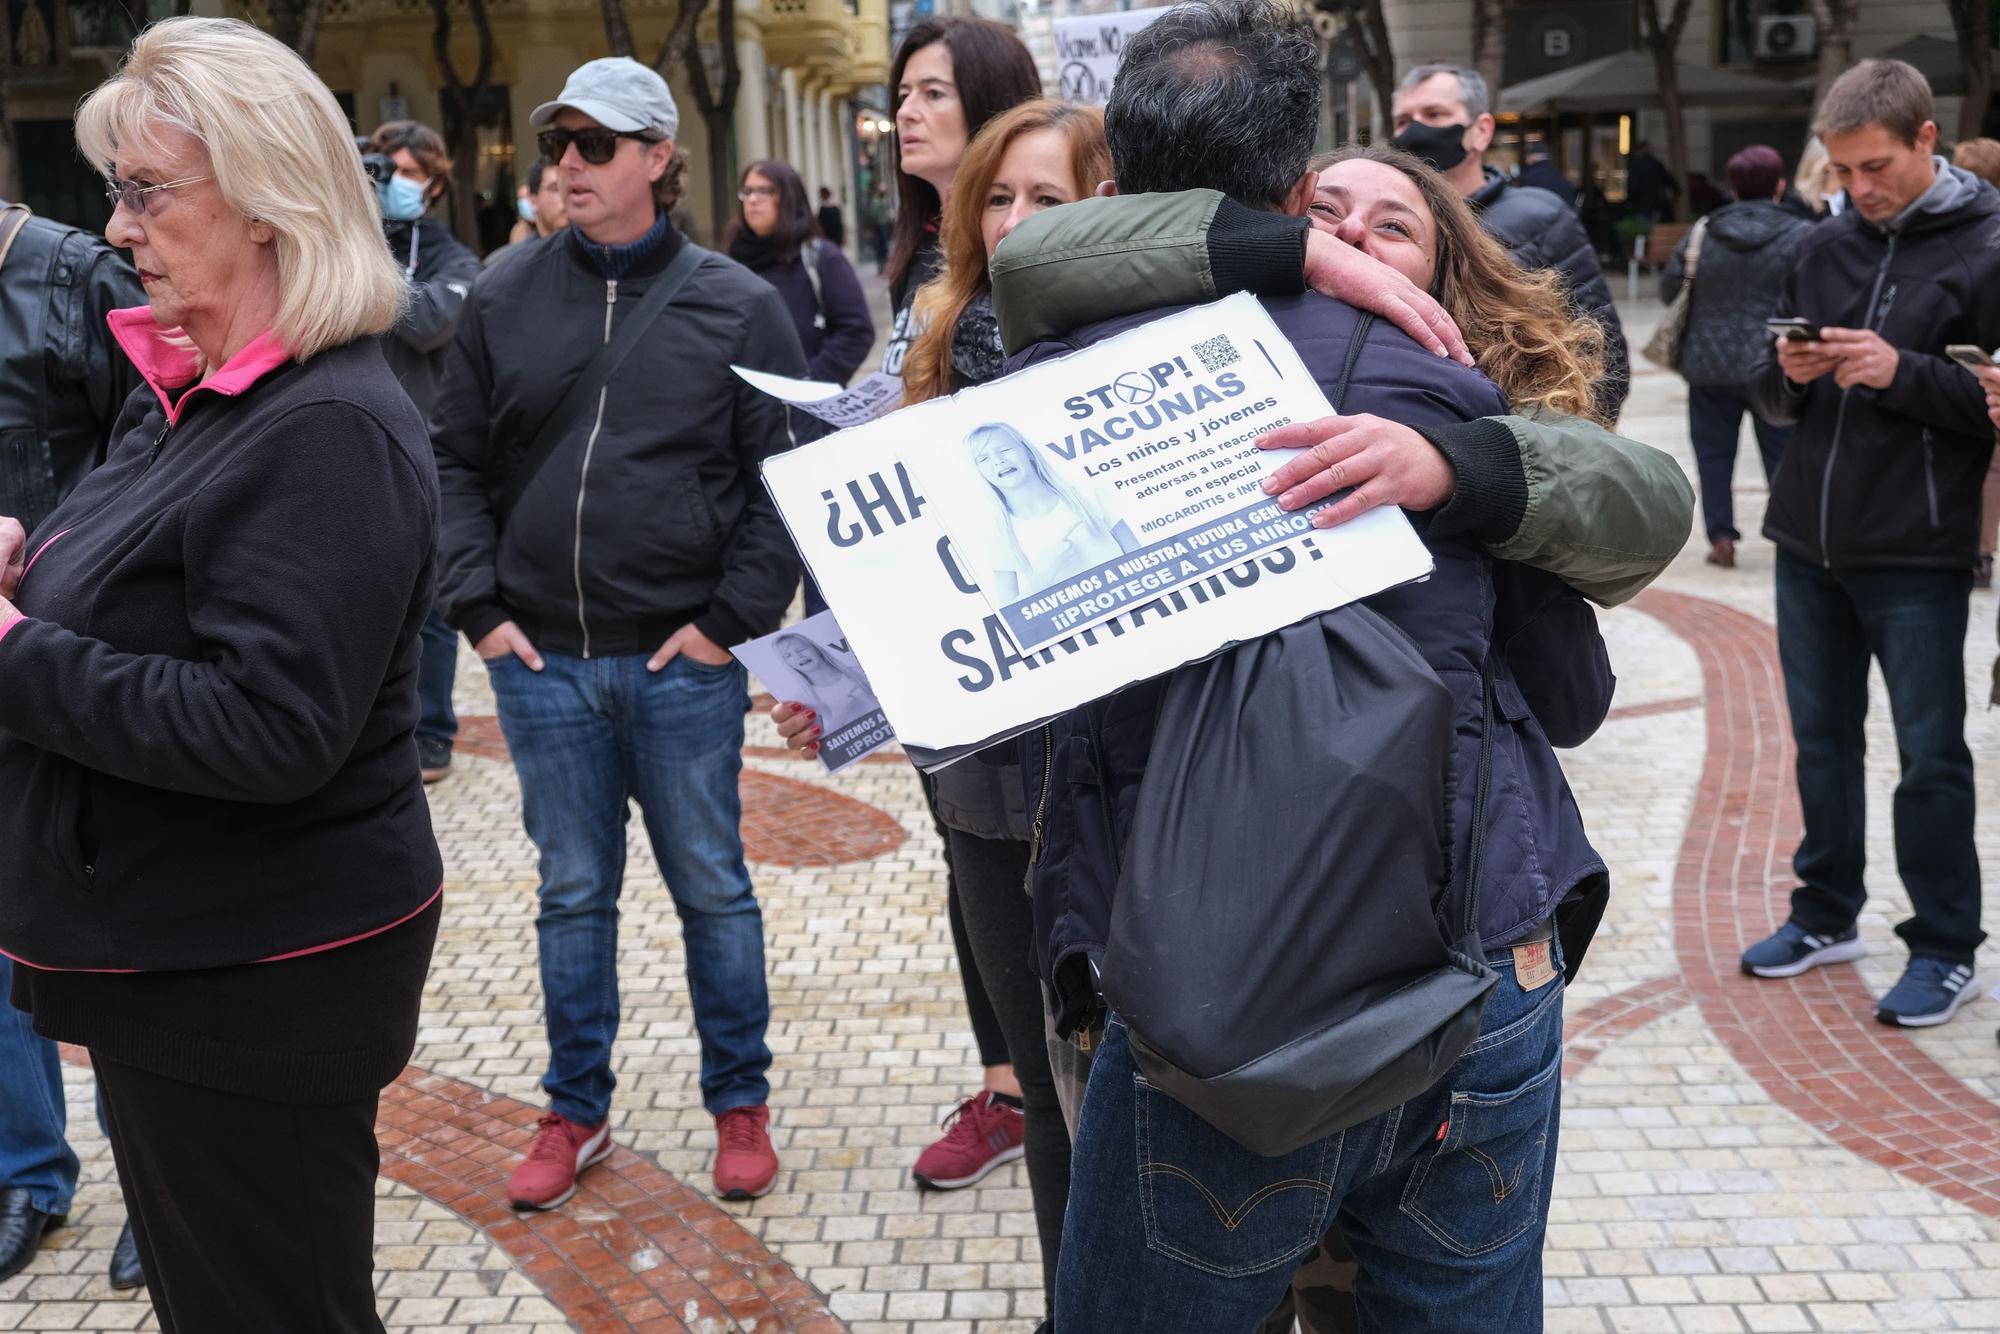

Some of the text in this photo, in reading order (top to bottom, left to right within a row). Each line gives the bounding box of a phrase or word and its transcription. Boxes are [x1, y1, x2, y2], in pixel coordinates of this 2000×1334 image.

[1544, 29, 1570, 56] B
[1046, 372, 1246, 461] VACUNAS
[1084, 396, 1278, 478] Los niños y jóvenes
[1114, 416, 1291, 490] Presentan más reacciones
[1136, 447, 1260, 499] adversas a las vac
[1185, 461, 1262, 498] en especial
[1140, 494, 1226, 534] MIOCARDITIS
[1227, 492, 1236, 500] e
[1021, 575, 1103, 620] SALVEMOS
[1104, 569, 1118, 584] A
[1118, 541, 1189, 579] NUESTRA
[1187, 518, 1250, 550] FUTURA
[1052, 570, 1176, 632] ¡¡PROTEGE
[1179, 555, 1199, 575] A
[1198, 538, 1248, 567] TUS
[826, 713, 886, 751] SALVEMOS A
[845, 724, 893, 758] ¡¡PROT
